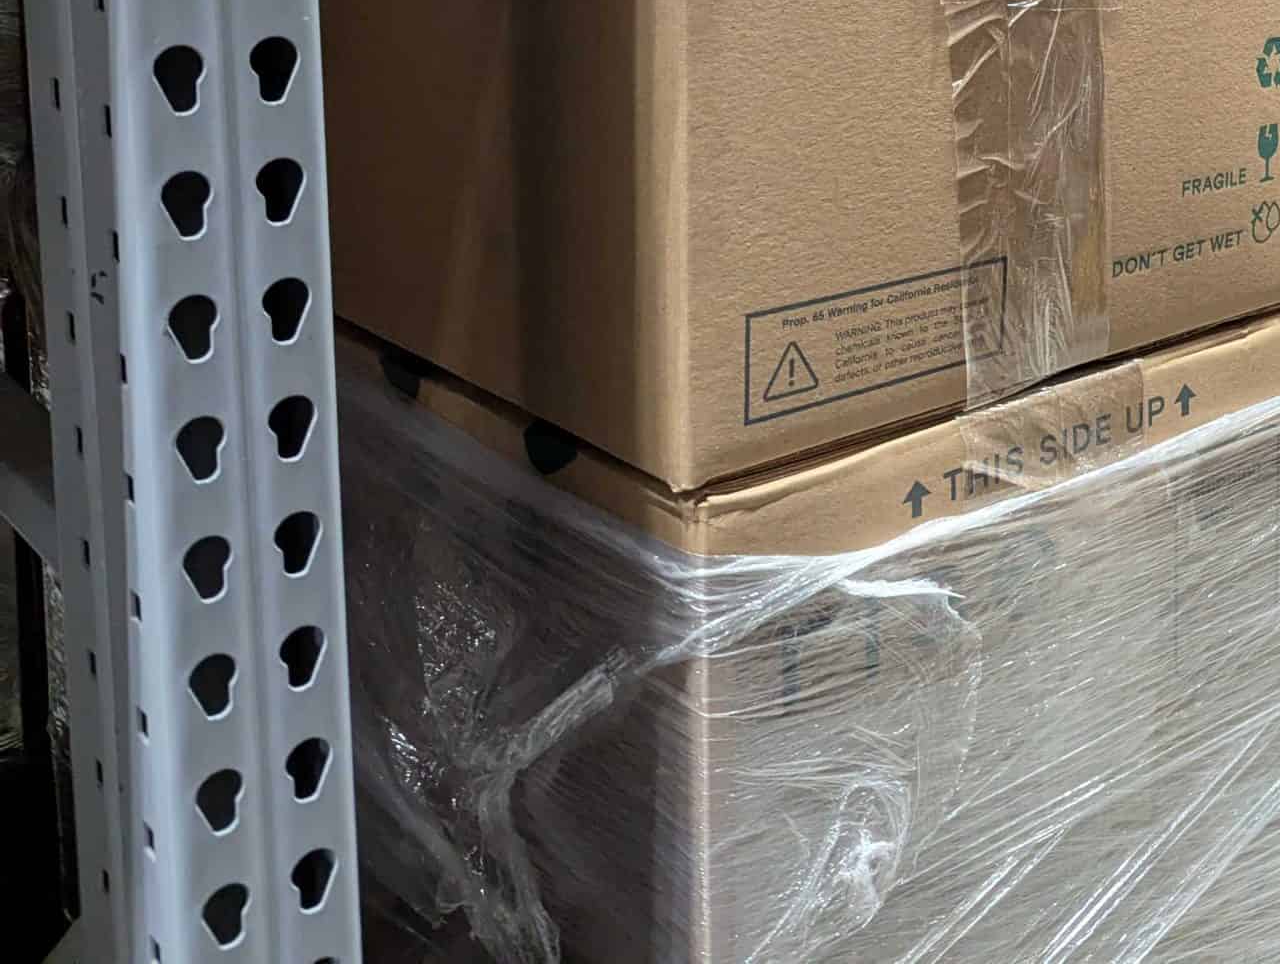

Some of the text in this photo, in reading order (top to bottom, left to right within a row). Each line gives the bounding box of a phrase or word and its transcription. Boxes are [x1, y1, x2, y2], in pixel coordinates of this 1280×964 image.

[1181, 167, 1248, 198] FRAGILE
[1112, 229, 1244, 278] DON'T GET WET
[782, 316, 809, 329] Prop.
[827, 302, 868, 319] Warning
[870, 297, 885, 308] for
[887, 285, 932, 304] California
[943, 395, 1166, 502] THIS SIDE UP
